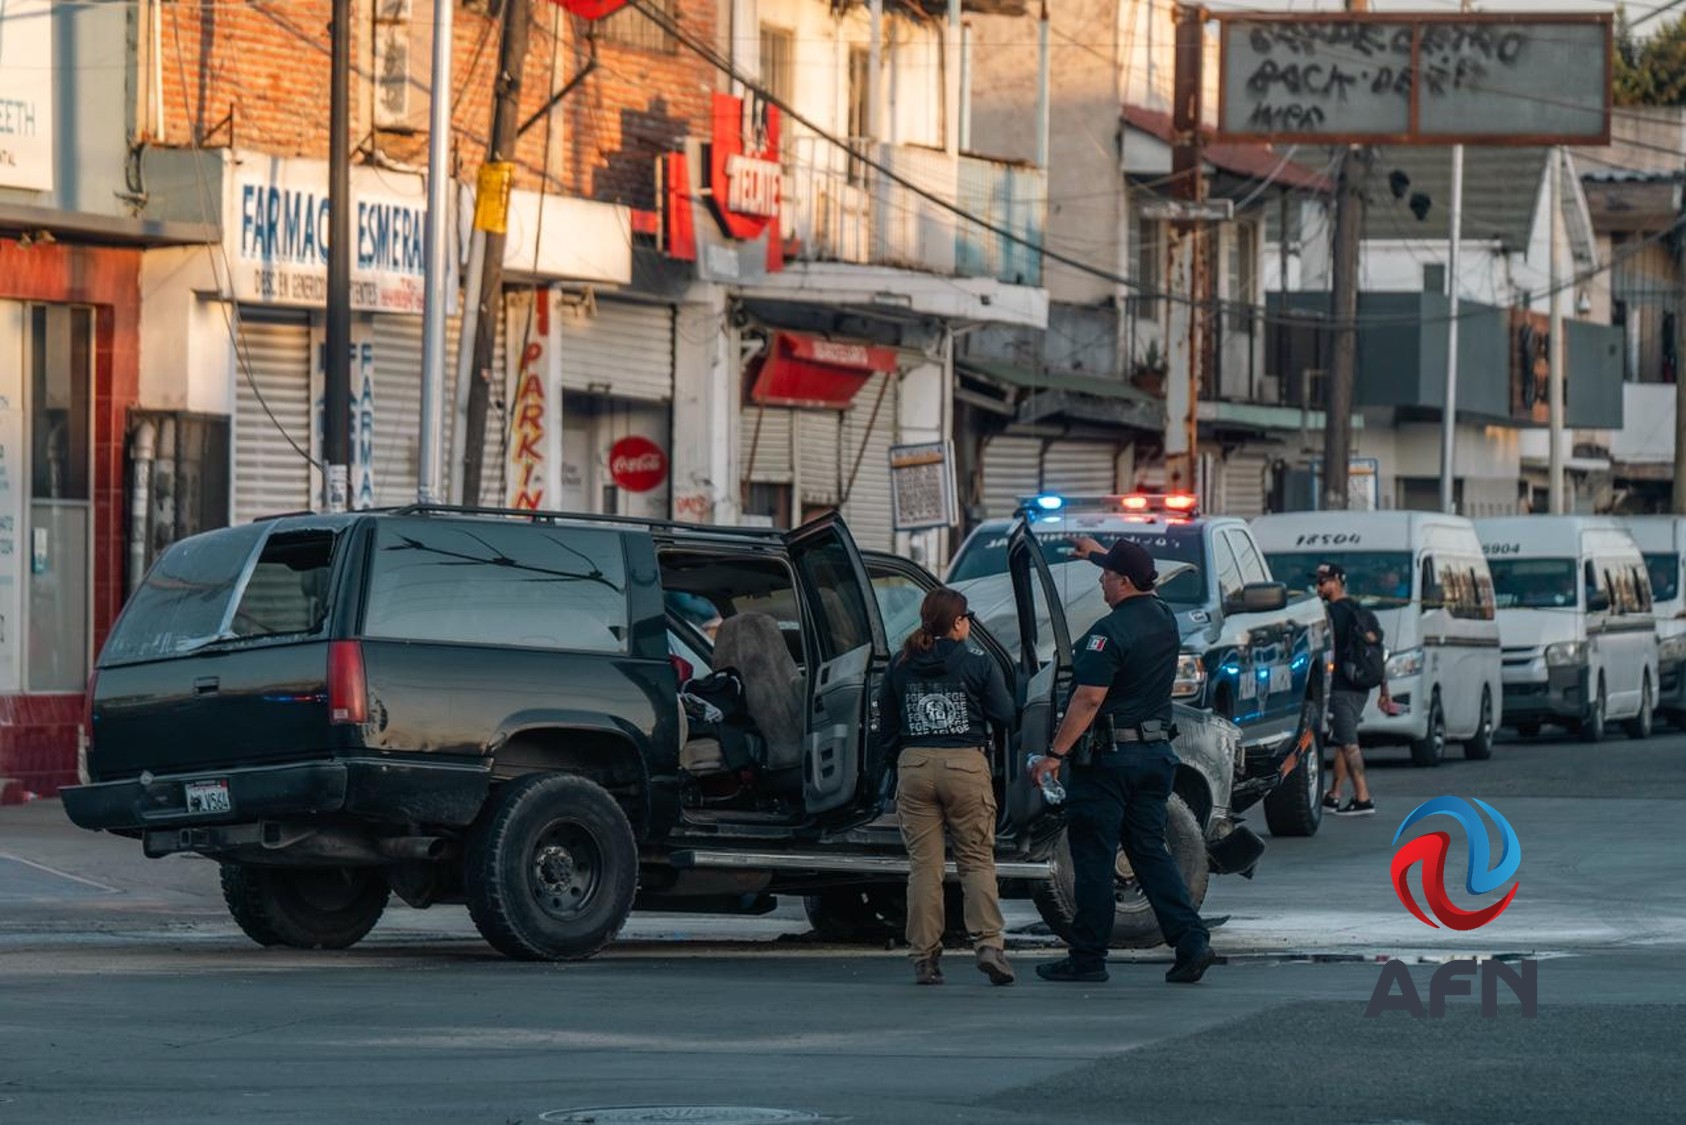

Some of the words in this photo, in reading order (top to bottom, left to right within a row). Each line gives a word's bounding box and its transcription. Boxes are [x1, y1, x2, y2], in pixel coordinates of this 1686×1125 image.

[241, 185, 329, 265] FARMAC
[357, 201, 426, 275] ESMERA
[360, 343, 374, 509] FARMA
[514, 341, 545, 510] PARKIN
